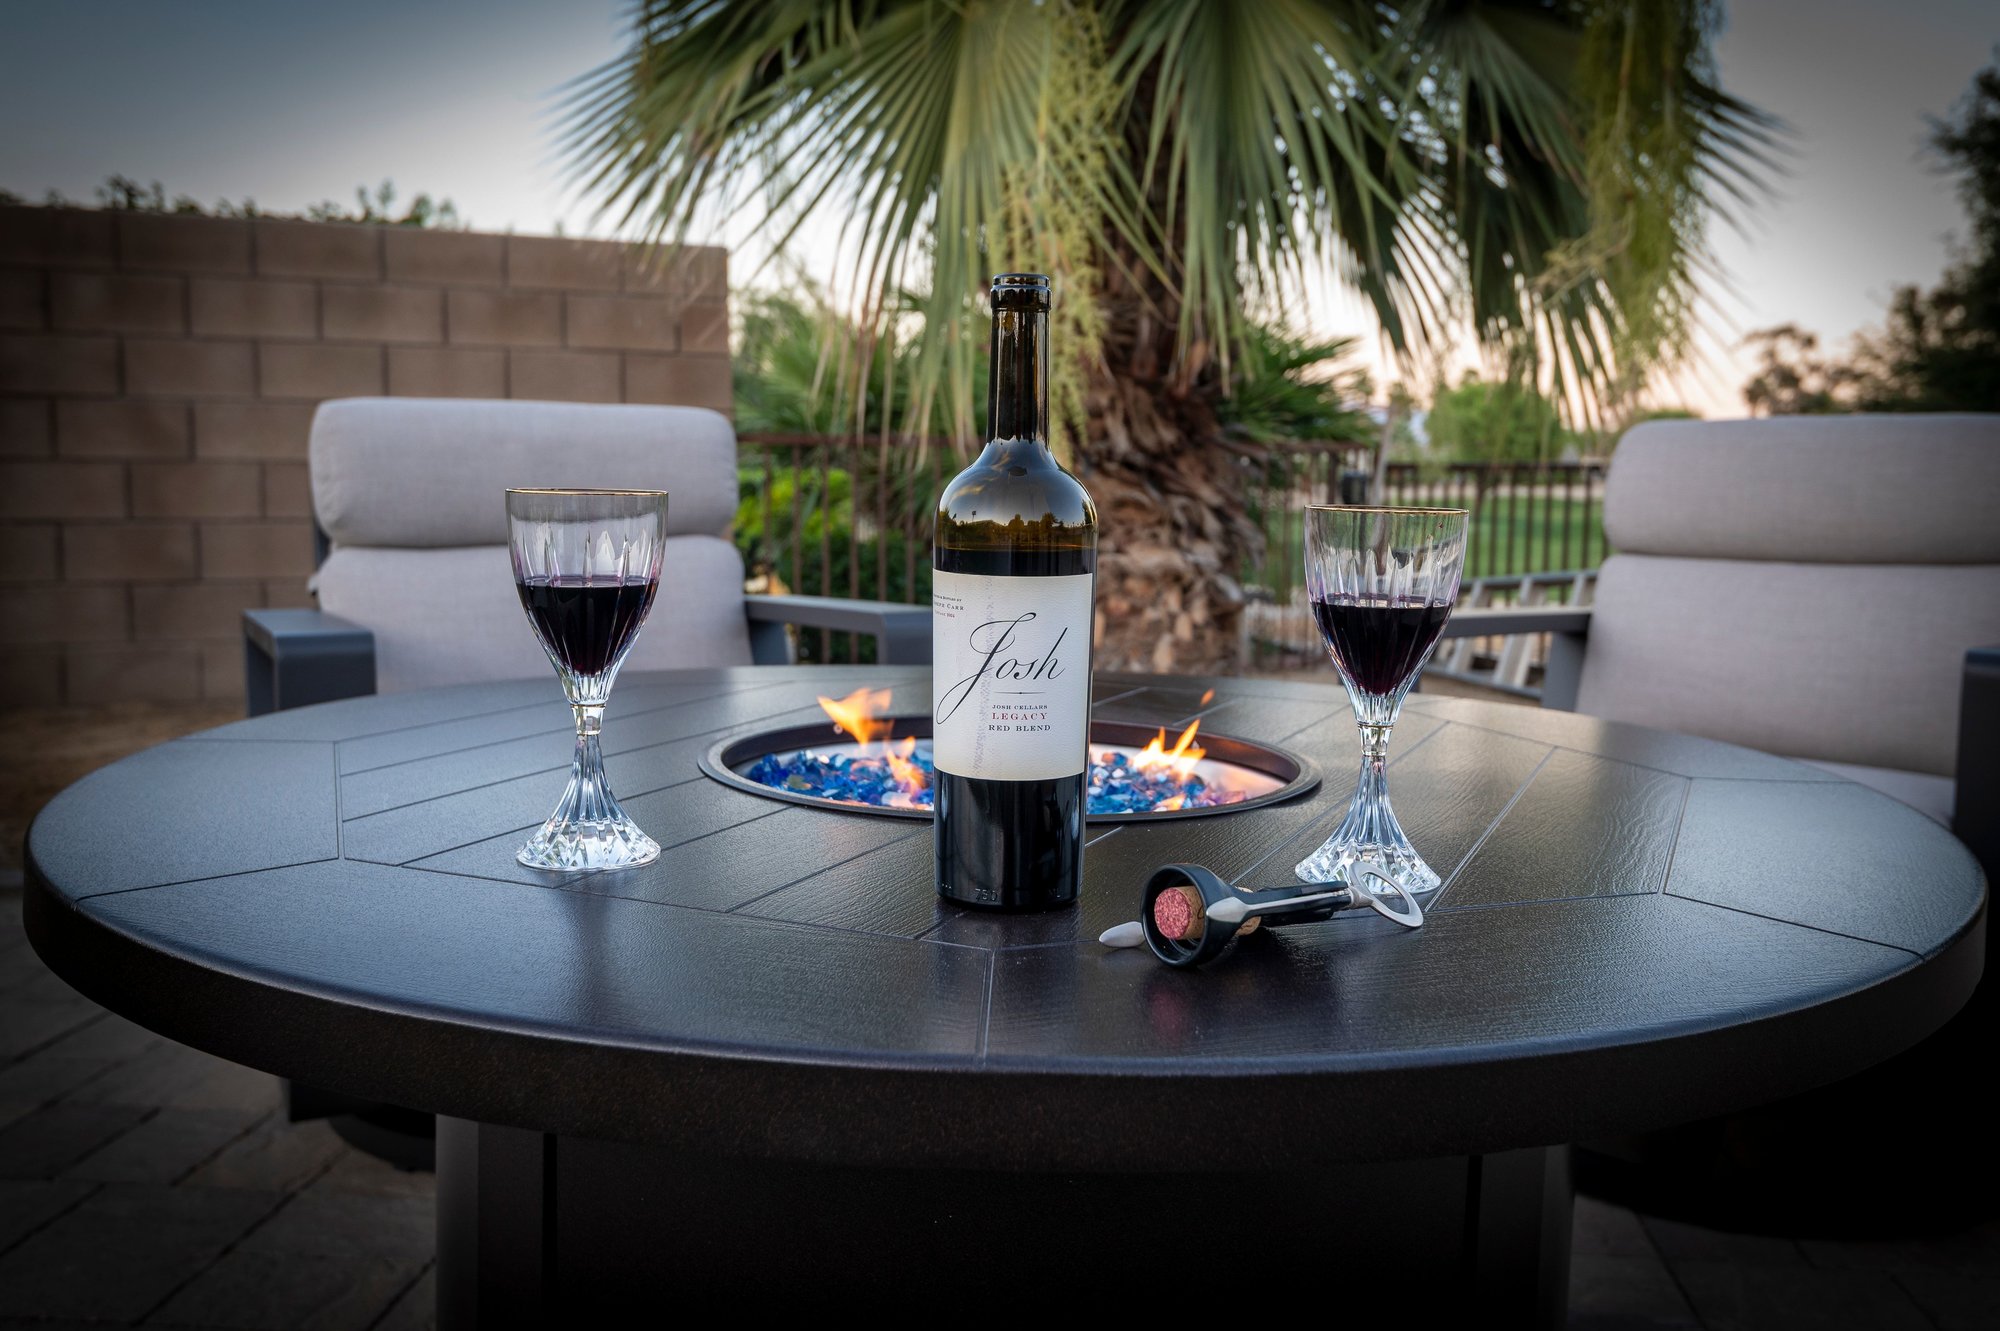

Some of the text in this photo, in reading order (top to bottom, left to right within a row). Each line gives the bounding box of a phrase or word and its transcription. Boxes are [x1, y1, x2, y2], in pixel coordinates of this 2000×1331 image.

[936, 612, 1068, 725] Josh
[992, 712, 1047, 720] LEGACY
[988, 724, 1051, 732] RED BLEND
